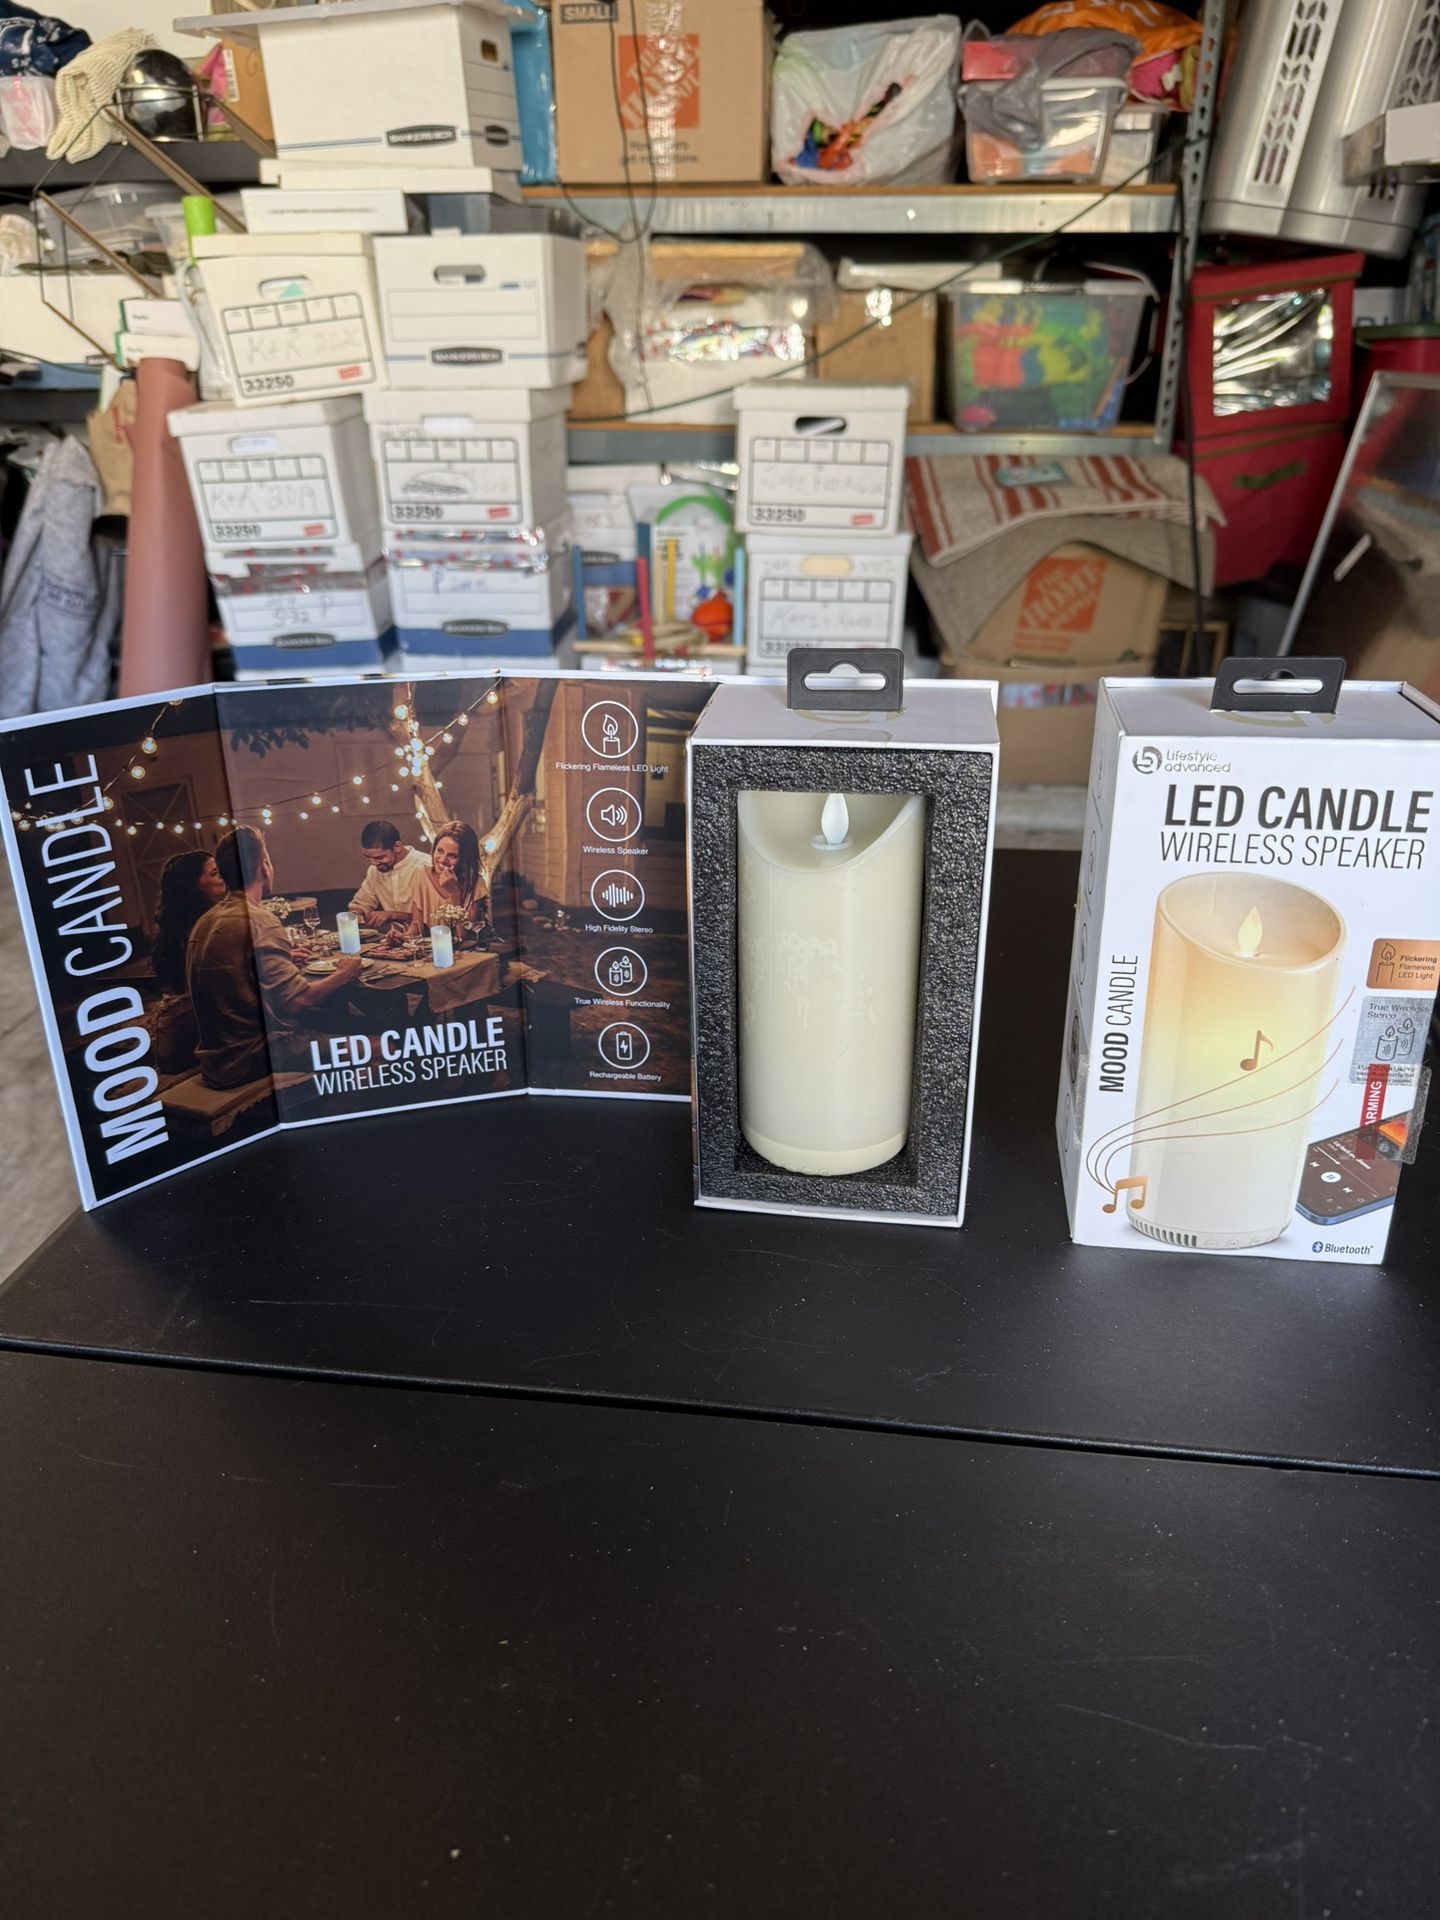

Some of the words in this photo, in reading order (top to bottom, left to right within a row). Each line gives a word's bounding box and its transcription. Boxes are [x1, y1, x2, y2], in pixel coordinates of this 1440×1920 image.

[564, 7, 612, 21] SMALL
[1166, 749, 1218, 763] Lifestyle
[555, 761, 591, 772] Flickering
[592, 762, 630, 772] Flameless
[631, 763, 649, 773] LED
[650, 764, 669, 774] Light
[1164, 761, 1232, 773] advanced
[1164, 783, 1245, 828] LED
[1257, 785, 1435, 834] CANDLE
[582, 845, 616, 855] Wireless
[616, 846, 649, 857] Speaker
[1160, 830, 1295, 866] WIRELESS
[1301, 835, 1426, 870] SPEAKER
[24, 753, 134, 978] CANDLE
[585, 923, 602, 933] High
[603, 924, 629, 935] Fidelity
[630, 925, 654, 934] Stereo
[1399, 954, 1438, 965] Flickering
[1398, 963, 1436, 972] Flameless
[1397, 971, 1414, 980] LED
[1415, 971, 1433, 980] Light
[1105, 954, 1139, 1027] CANDLE
[574, 997, 592, 1006] True
[592, 997, 624, 1007] Wireless
[625, 998, 671, 1010] Functionality
[1368, 1002, 1389, 1012] True
[1367, 1011, 1397, 1020] Stereo
[309, 1033, 372, 1072] LED
[379, 1016, 506, 1062] CANDLE
[1098, 1031, 1130, 1093] MOOD
[76, 985, 170, 1166] MOOD
[312, 1060, 417, 1096] WIRELESS
[420, 1048, 508, 1081] SPEAKER
[589, 1070, 637, 1082] Rechargeable
[637, 1072, 662, 1083] Battery
[1324, 1242, 1372, 1256] Bluetooth
